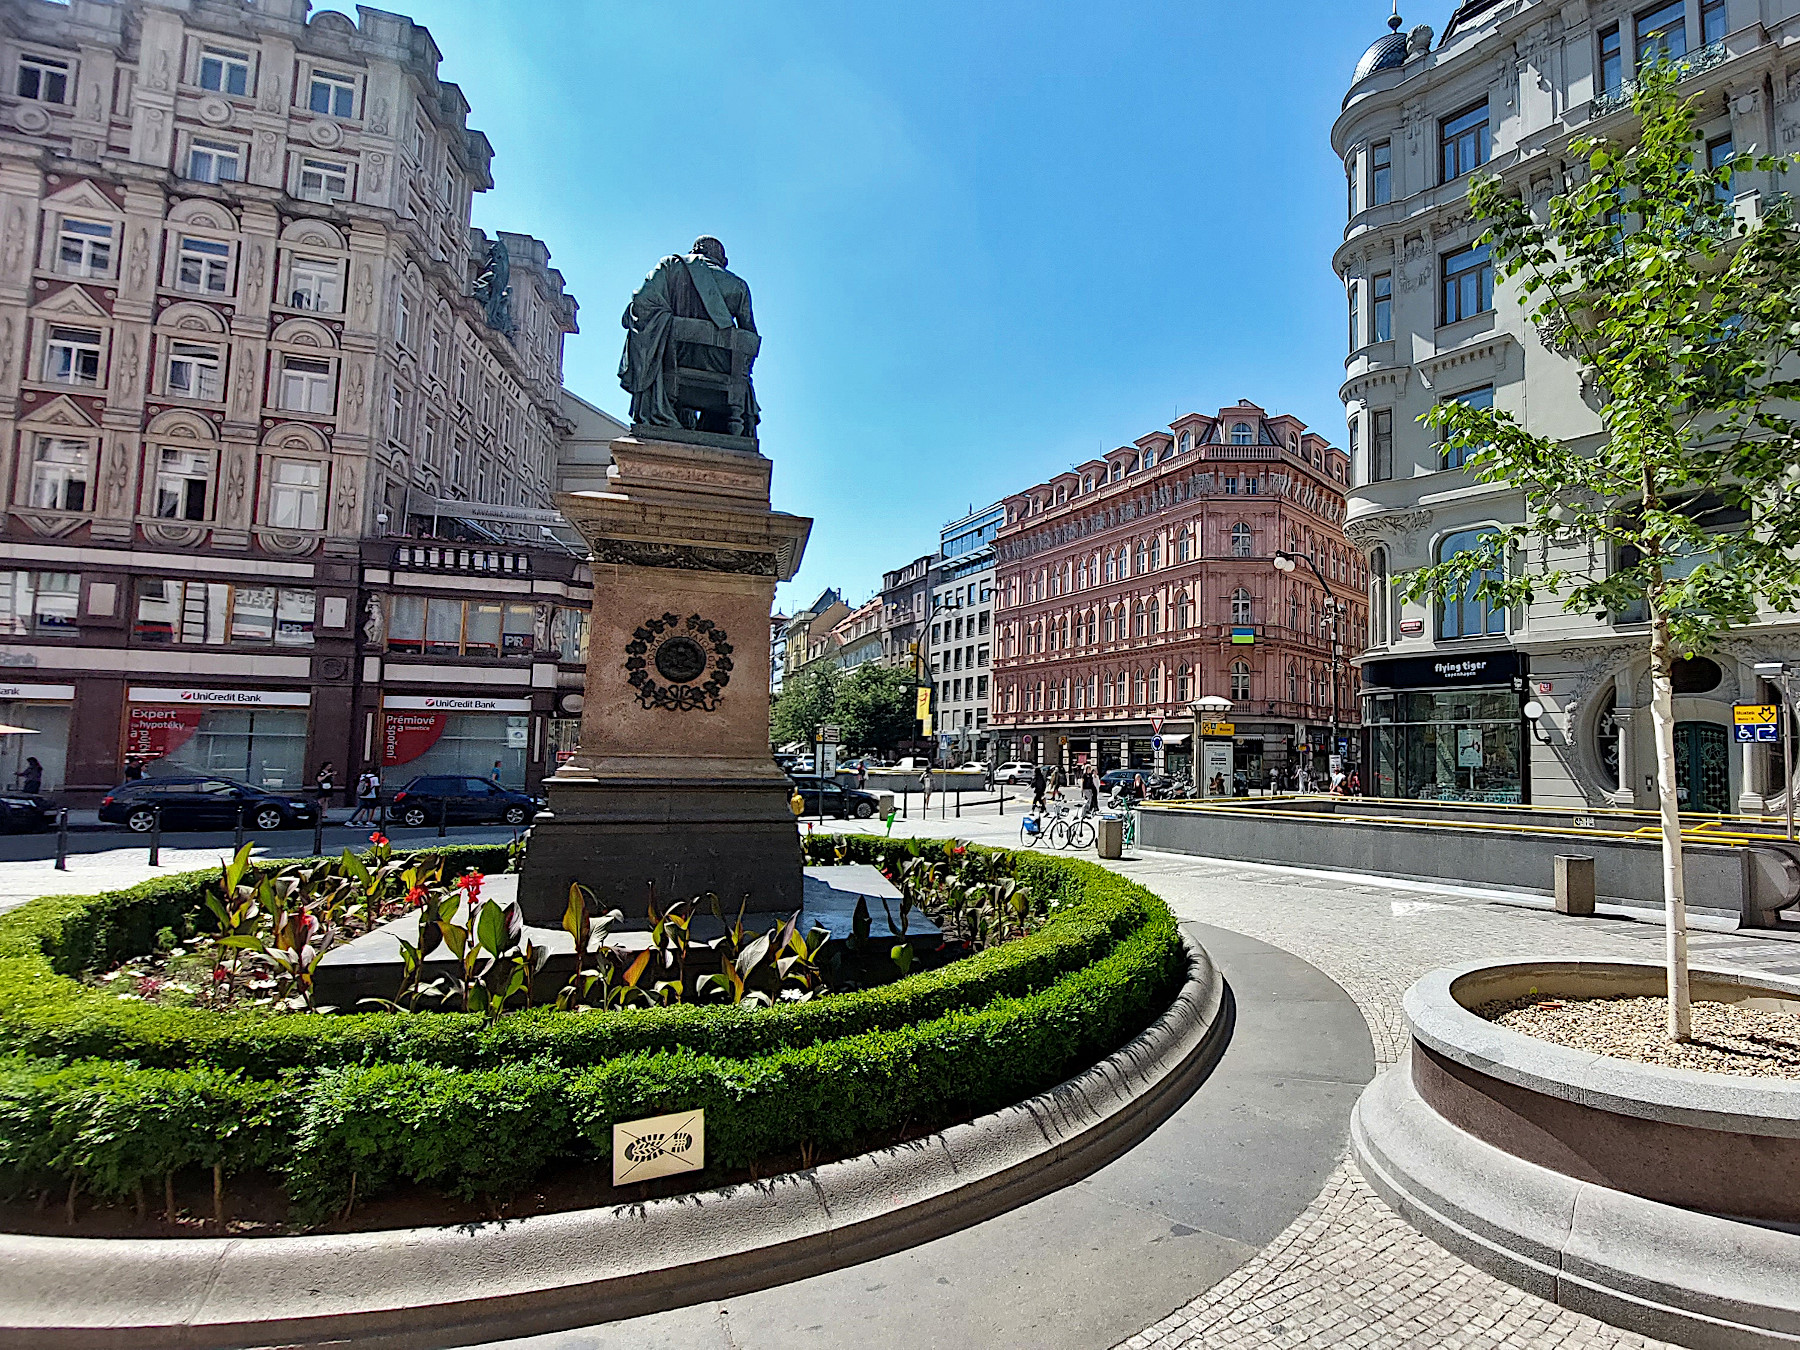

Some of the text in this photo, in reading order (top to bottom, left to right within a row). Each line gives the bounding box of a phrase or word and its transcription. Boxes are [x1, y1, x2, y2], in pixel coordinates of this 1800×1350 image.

[498, 370, 520, 400] ADRIA
[1434, 660, 1487, 674] flying tiger
[192, 692, 261, 702] UniCredit Bank
[435, 699, 496, 709] UniCredit Bank
[132, 709, 177, 720] Expert
[386, 715, 435, 725] Prémiové
[386, 725, 398, 759] spoření
